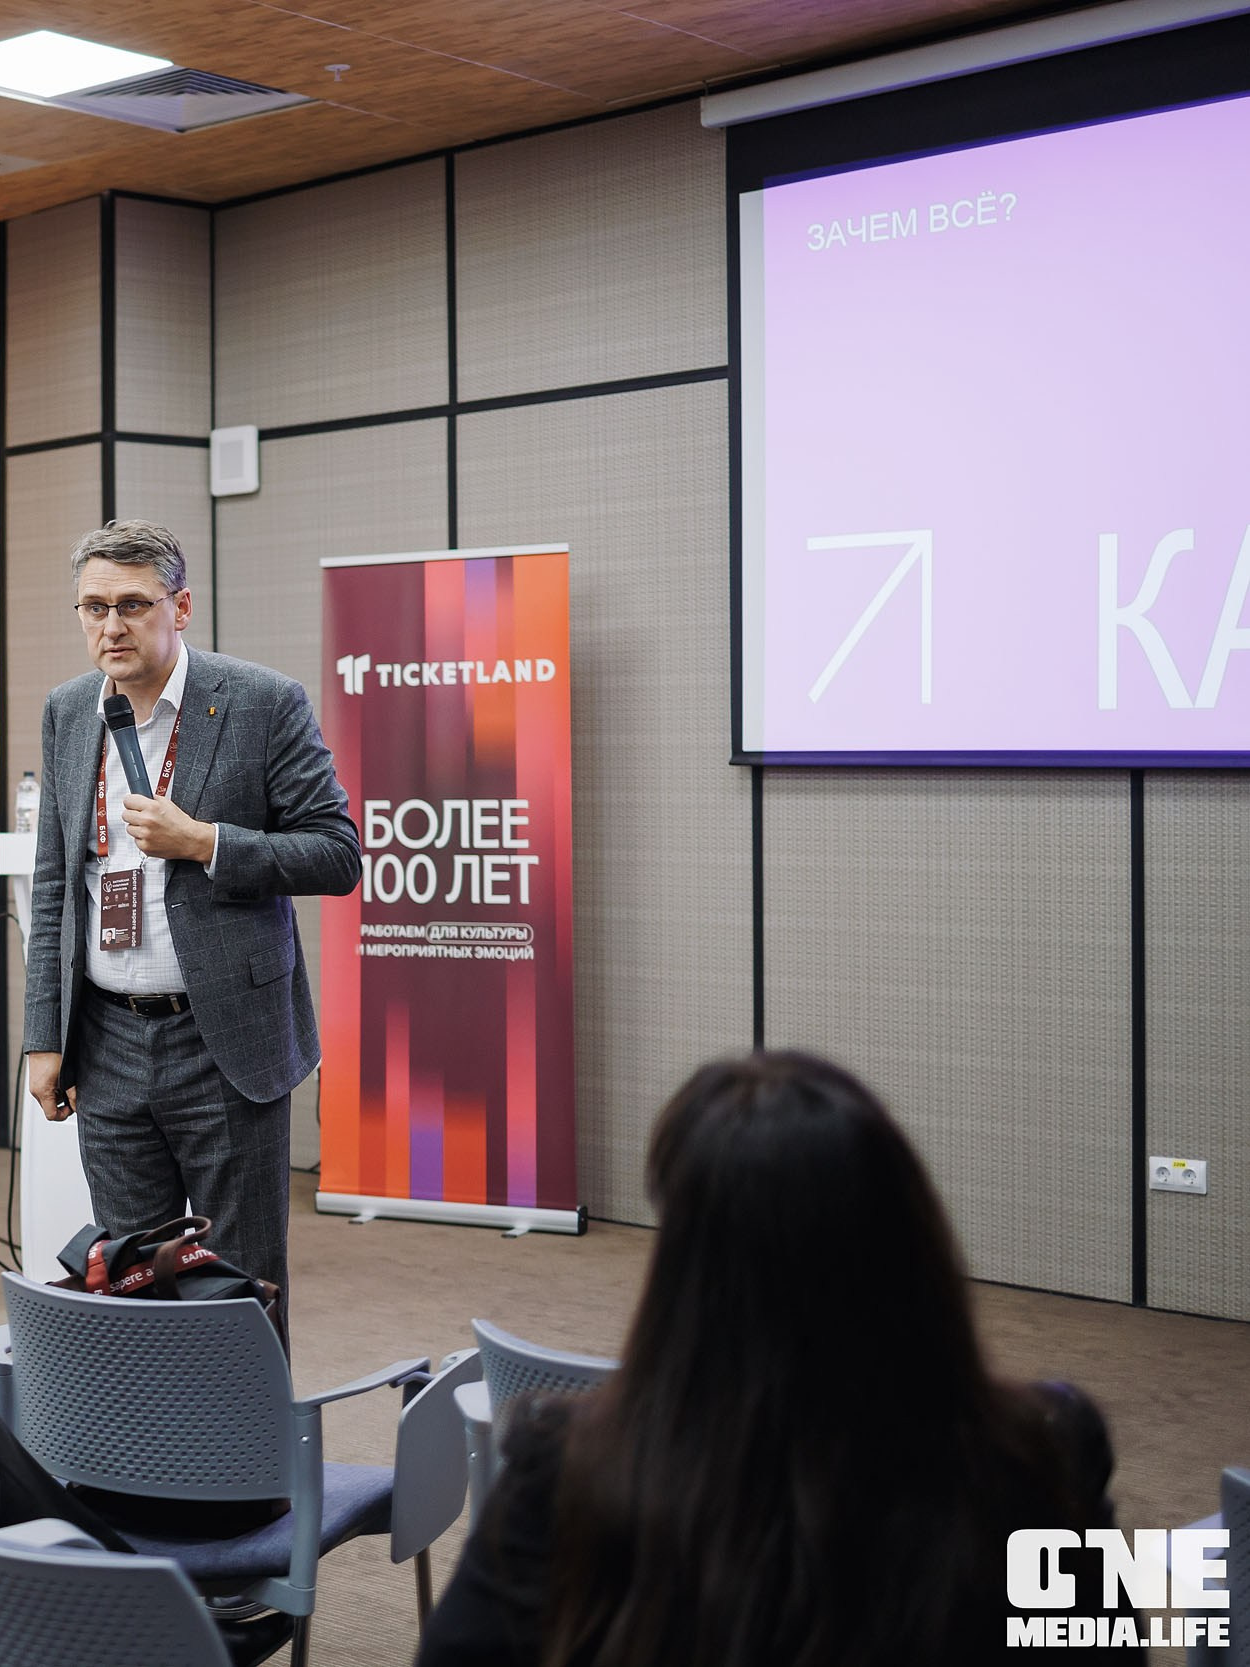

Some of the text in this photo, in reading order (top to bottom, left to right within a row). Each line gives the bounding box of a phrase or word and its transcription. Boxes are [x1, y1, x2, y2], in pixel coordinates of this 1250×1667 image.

[807, 190, 1017, 251] ЗАЧЕМ ВСЁ?
[375, 658, 556, 688] TICKETLAND
[162, 760, 173, 778] БКФ
[99, 825, 107, 844] БКФ
[364, 798, 530, 850] БОЛЕЕ
[361, 853, 540, 905] 100 ЛЕТ
[360, 924, 528, 941] РАБОТАЕМ ДЛЯ КУЛЬТУРЫ
[365, 943, 473, 959] МЕРОПРИЯТНЫХ
[474, 944, 534, 962] ЭМОЦИЙ
[110, 1271, 144, 1293] sapere
